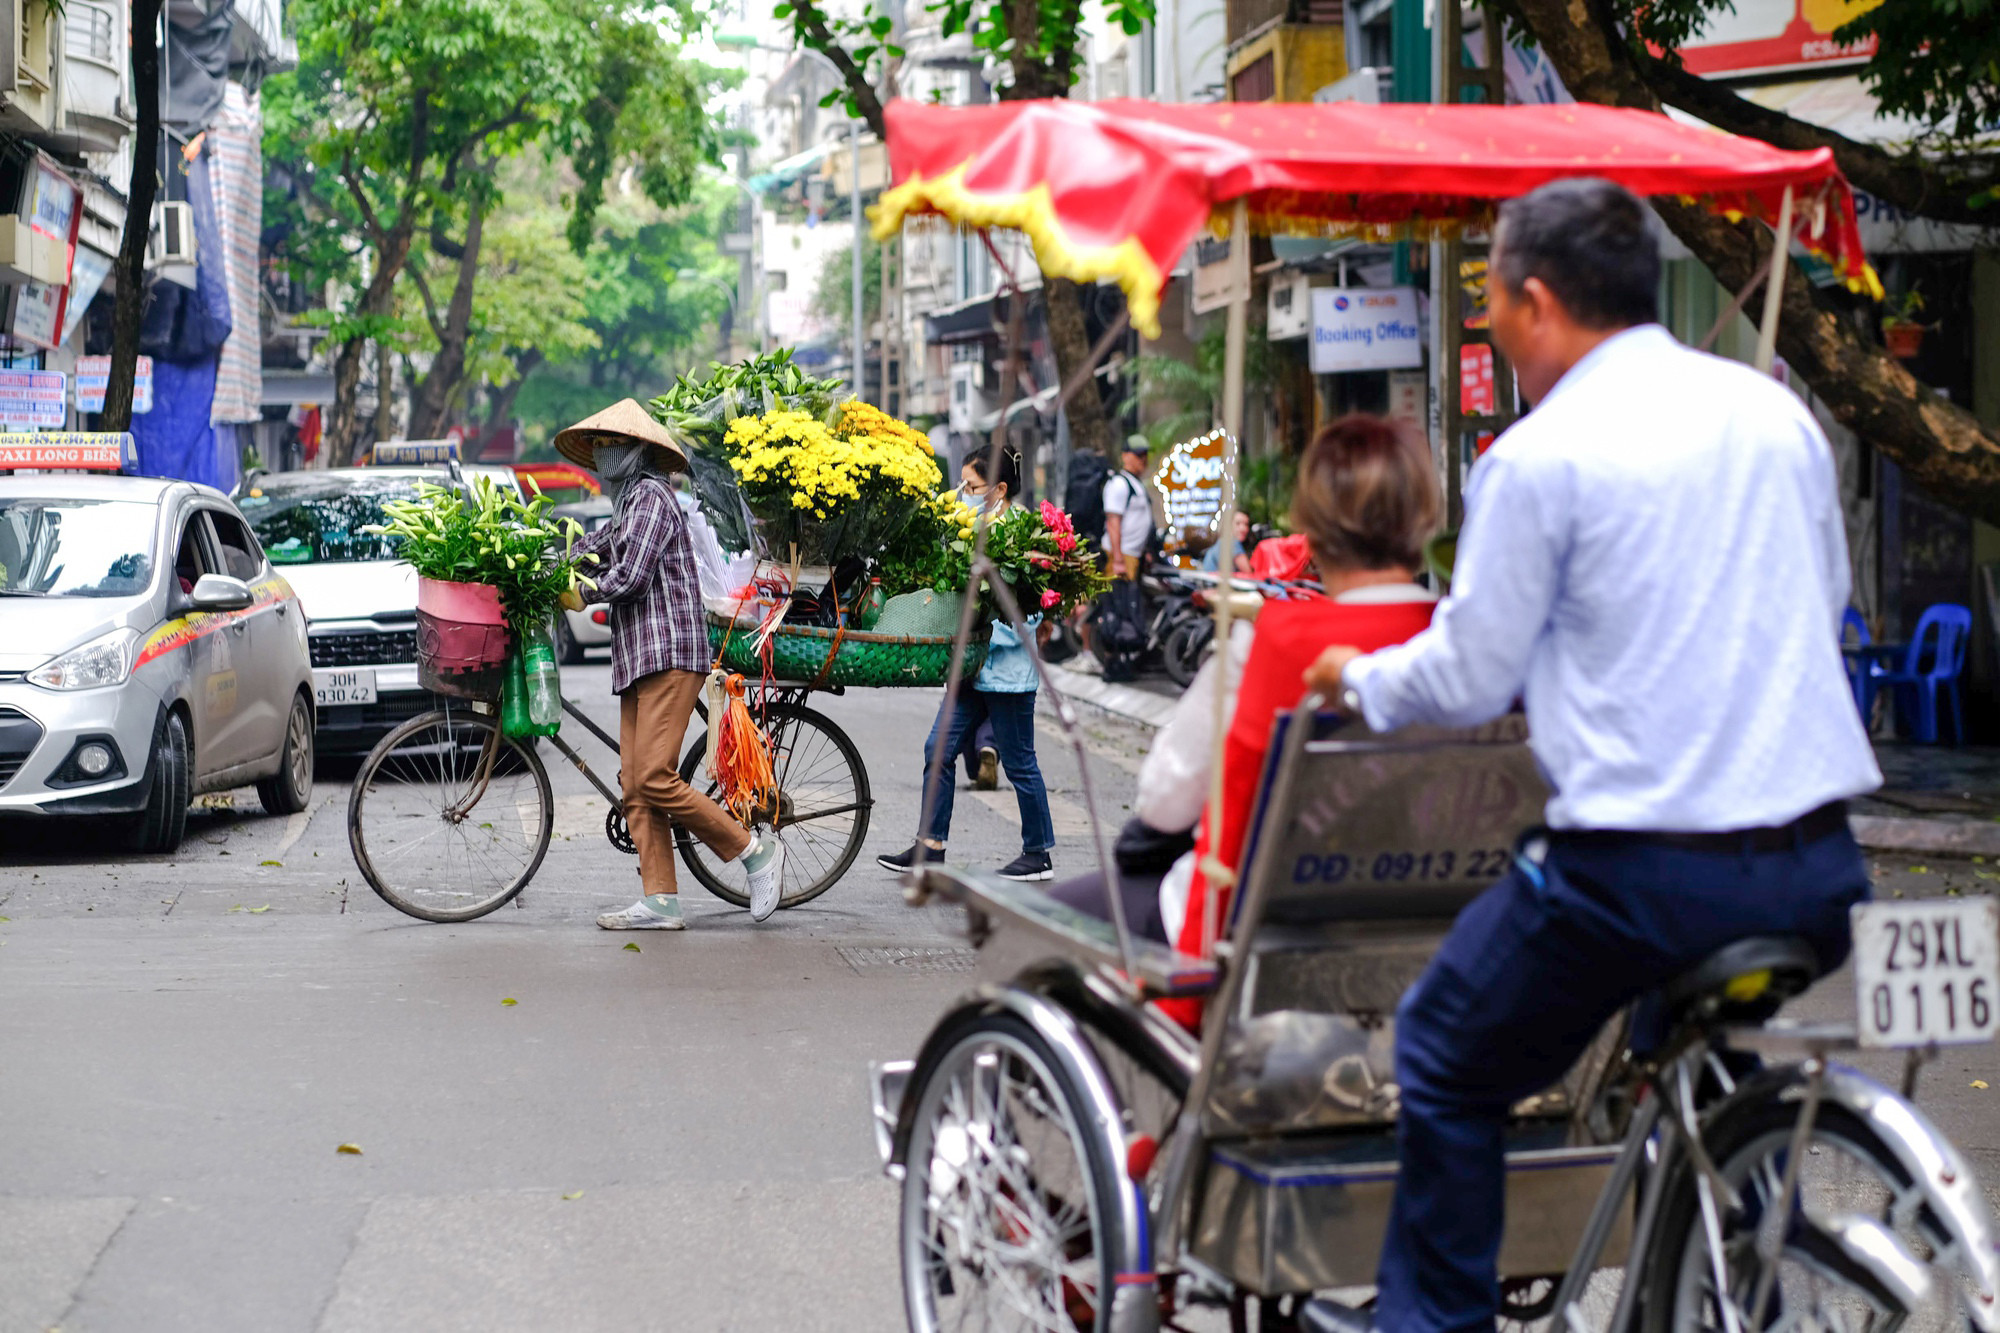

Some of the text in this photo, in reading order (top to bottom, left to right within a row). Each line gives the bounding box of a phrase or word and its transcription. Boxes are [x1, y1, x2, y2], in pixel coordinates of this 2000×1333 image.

[1315, 320, 1417, 346] Booking Office
[77, 359, 111, 374] BOOKIN
[29, 432, 119, 445] 38.736.736
[36, 449, 79, 462] LONG
[1171, 452, 1222, 489] Spa
[329, 673, 357, 687] 30H
[317, 688, 369, 703] 930.42
[1371, 851, 1457, 882] 0913
[1884, 917, 1974, 971] 29XL
[1873, 976, 1990, 1034] 0116
